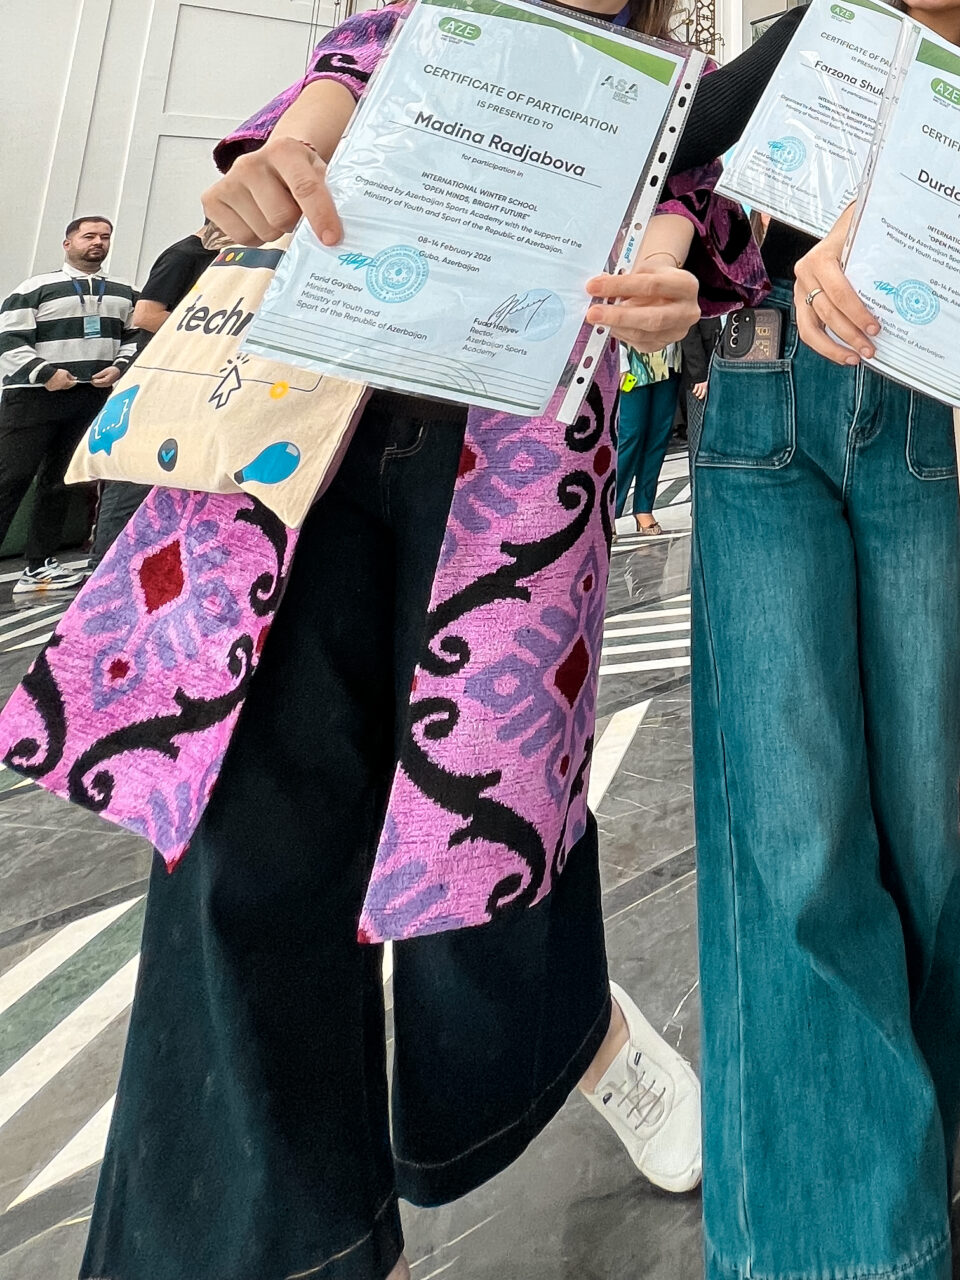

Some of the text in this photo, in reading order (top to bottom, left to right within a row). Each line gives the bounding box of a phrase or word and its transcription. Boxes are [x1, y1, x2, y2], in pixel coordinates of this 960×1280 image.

[834, 7, 852, 19] AZE
[444, 21, 475, 37] AZE
[820, 31, 880, 60] CERTIFICATE OF
[814, 60, 858, 85] Farzona
[423, 64, 506, 97] CERTIFICATE
[506, 90, 526, 102] OF
[525, 96, 618, 134] PARTICIPATION
[600, 75, 639, 98] ASA
[936, 82, 960, 102] AZE
[476, 99, 554, 130] IS PRESENTED TO
[414, 111, 585, 177] Madina Radjabova
[461, 153, 524, 178] for participation in
[421, 171, 537, 212] INTERNATIONAL WINTER SCHOOL
[471, 198, 500, 211] BRIGHT
[354, 175, 395, 192] Organized
[393, 186, 405, 196] by
[404, 190, 444, 207] Azerbaijan
[444, 201, 469, 214] Sports
[469, 209, 504, 226] Academy
[504, 221, 520, 230] with
[520, 225, 533, 234] the
[533, 229, 561, 242] support
[570, 240, 582, 248] the
[363, 189, 393, 205] Ministry
[403, 201, 424, 213] Youth
[424, 209, 441, 218] and
[440, 212, 462, 224] Sport
[471, 222, 484, 230] the
[484, 225, 516, 240] Republic
[417, 235, 491, 262] 08-14 February 2026
[441, 256, 480, 272] Azerbaijan
[309, 272, 363, 292] Farid Gayibov
[300, 290, 331, 305] Ministry
[342, 300, 363, 313] Youth
[363, 308, 380, 317] and
[296, 299, 427, 340] Sport of the Republic of Azerbaijan
